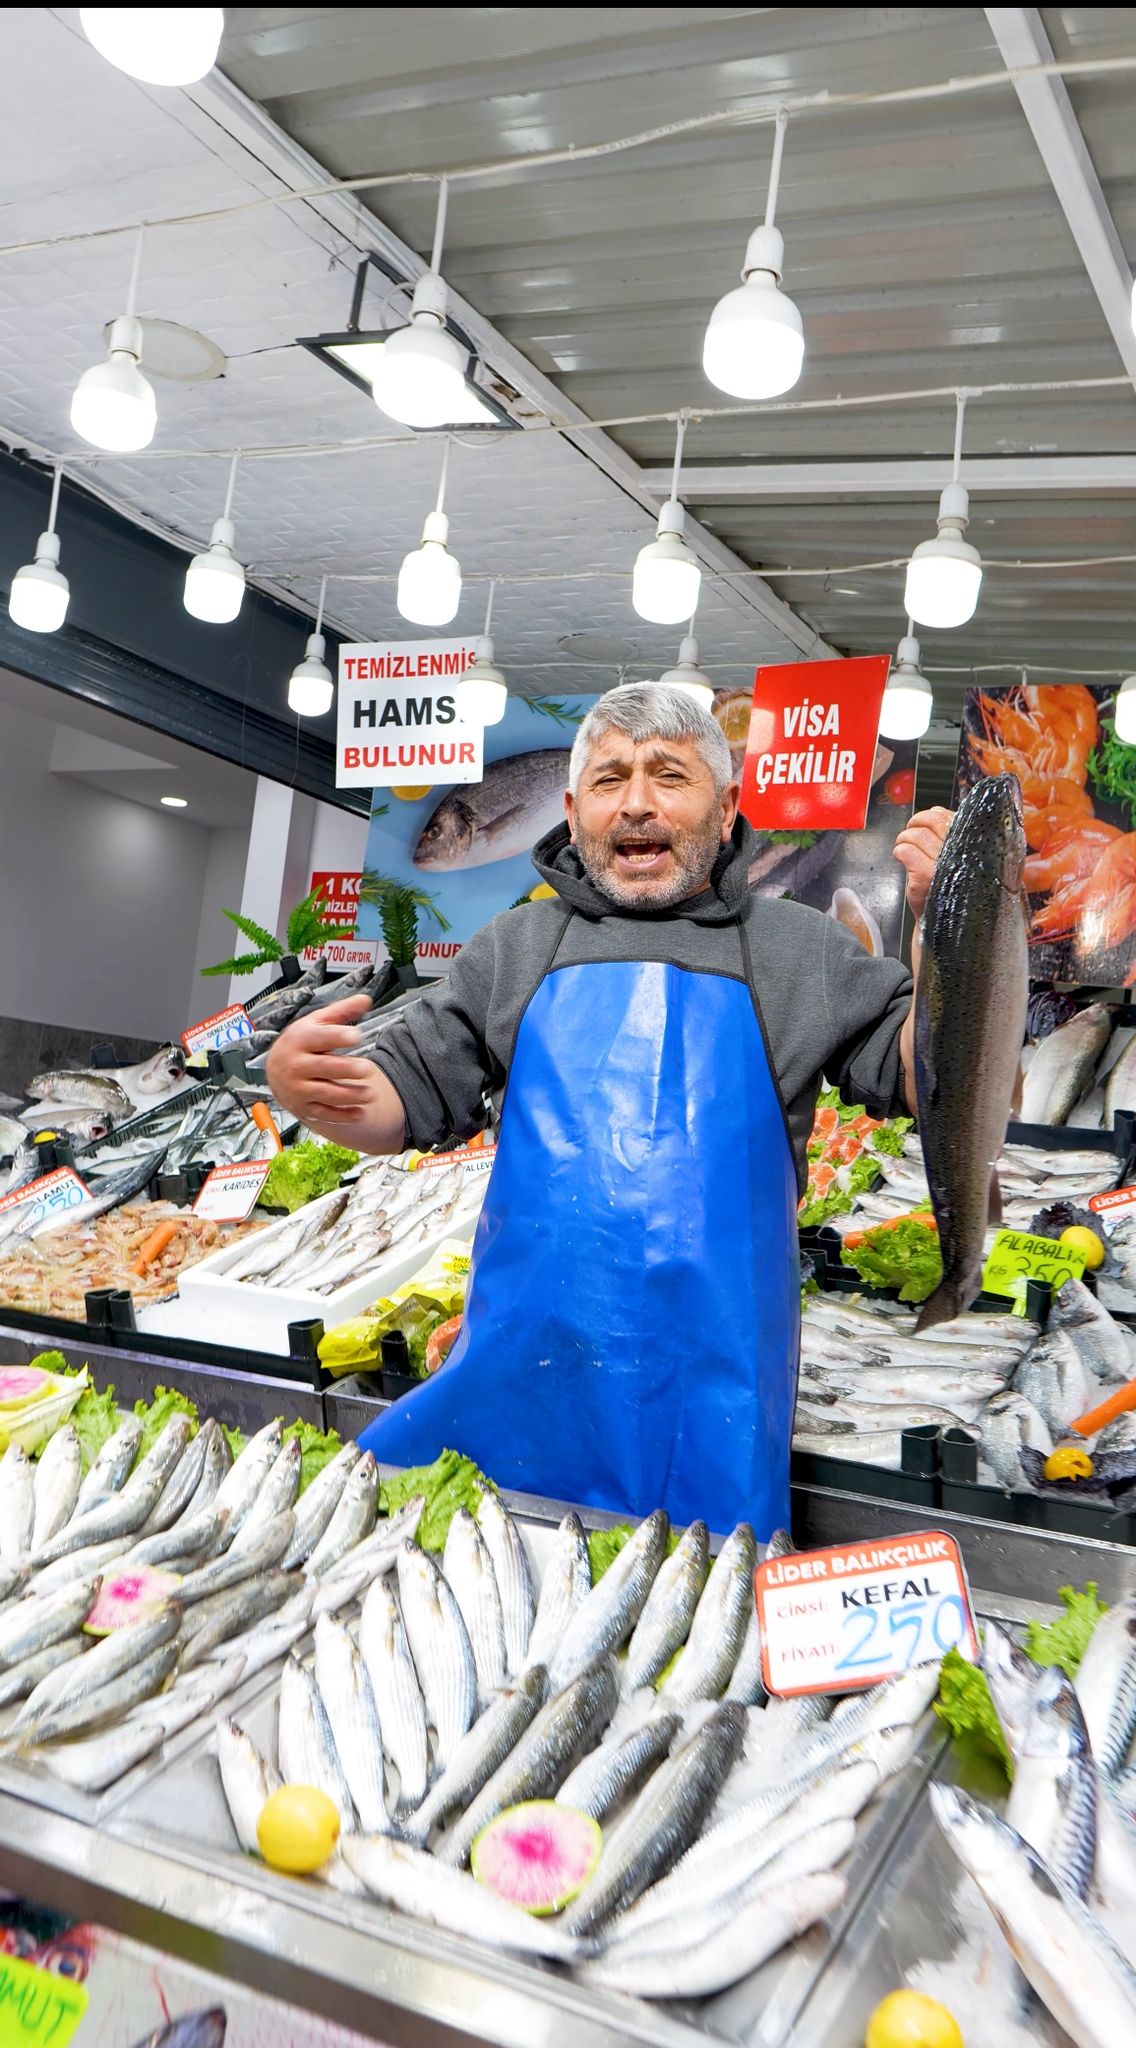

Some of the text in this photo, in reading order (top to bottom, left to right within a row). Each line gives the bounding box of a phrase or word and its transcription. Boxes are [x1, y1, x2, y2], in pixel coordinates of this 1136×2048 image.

[353, 696, 465, 728] HAMS
[783, 698, 840, 738] VİSA
[344, 742, 476, 769] BULUNUR
[756, 743, 857, 794] ÇEKİLİR
[326, 878, 335, 895] 1
[303, 944, 325, 961] NET
[327, 945, 346, 962] 700
[418, 942, 463, 959] UNUR
[422, 1148, 497, 1167] LİDER BALIKÇIL
[35, 1178, 76, 1204] LAMUT
[1095, 1193, 1131, 1208] LİDER
[766, 1540, 950, 1585] LİDER BALIKÇILIK
[840, 1577, 941, 1609] KEFAL
[833, 1593, 968, 1672] 250
[0, 1968, 80, 2047] MUT
